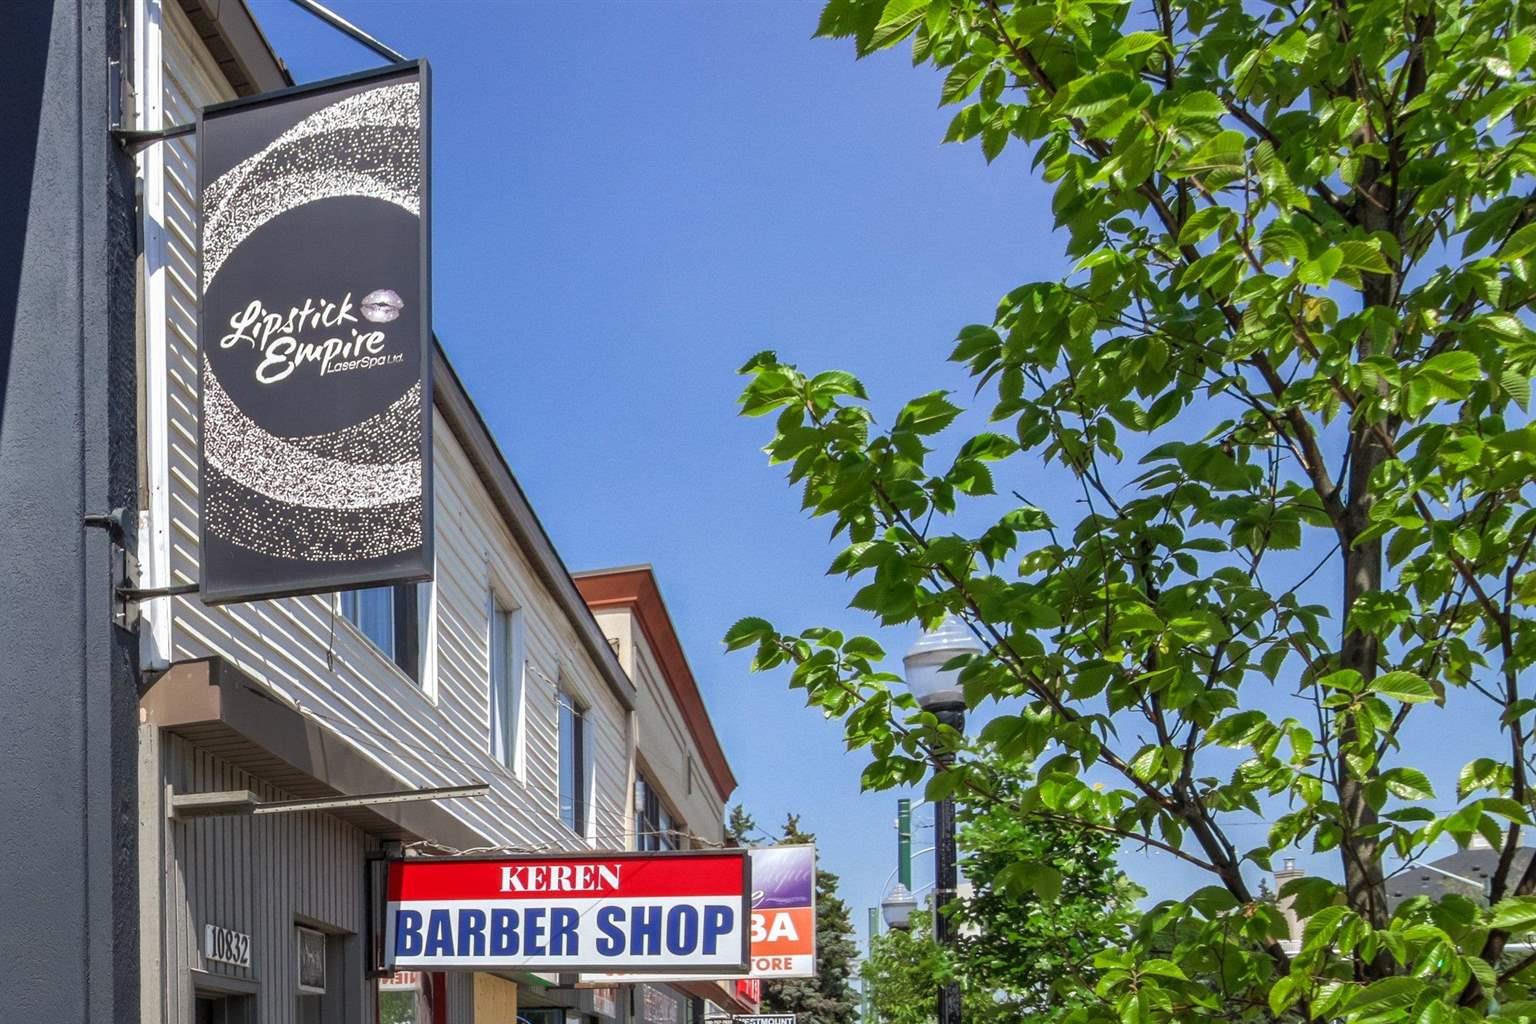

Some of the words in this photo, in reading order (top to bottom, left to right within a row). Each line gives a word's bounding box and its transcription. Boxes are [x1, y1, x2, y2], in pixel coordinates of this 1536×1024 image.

[220, 292, 358, 351] Lipstick
[256, 328, 385, 384] Empire
[327, 354, 386, 374] LaserSpa
[499, 864, 622, 892] KEREN
[212, 927, 249, 964] 10832
[395, 907, 580, 957] BARBER
[596, 904, 734, 957] SHOP
[751, 957, 793, 971] ORE
